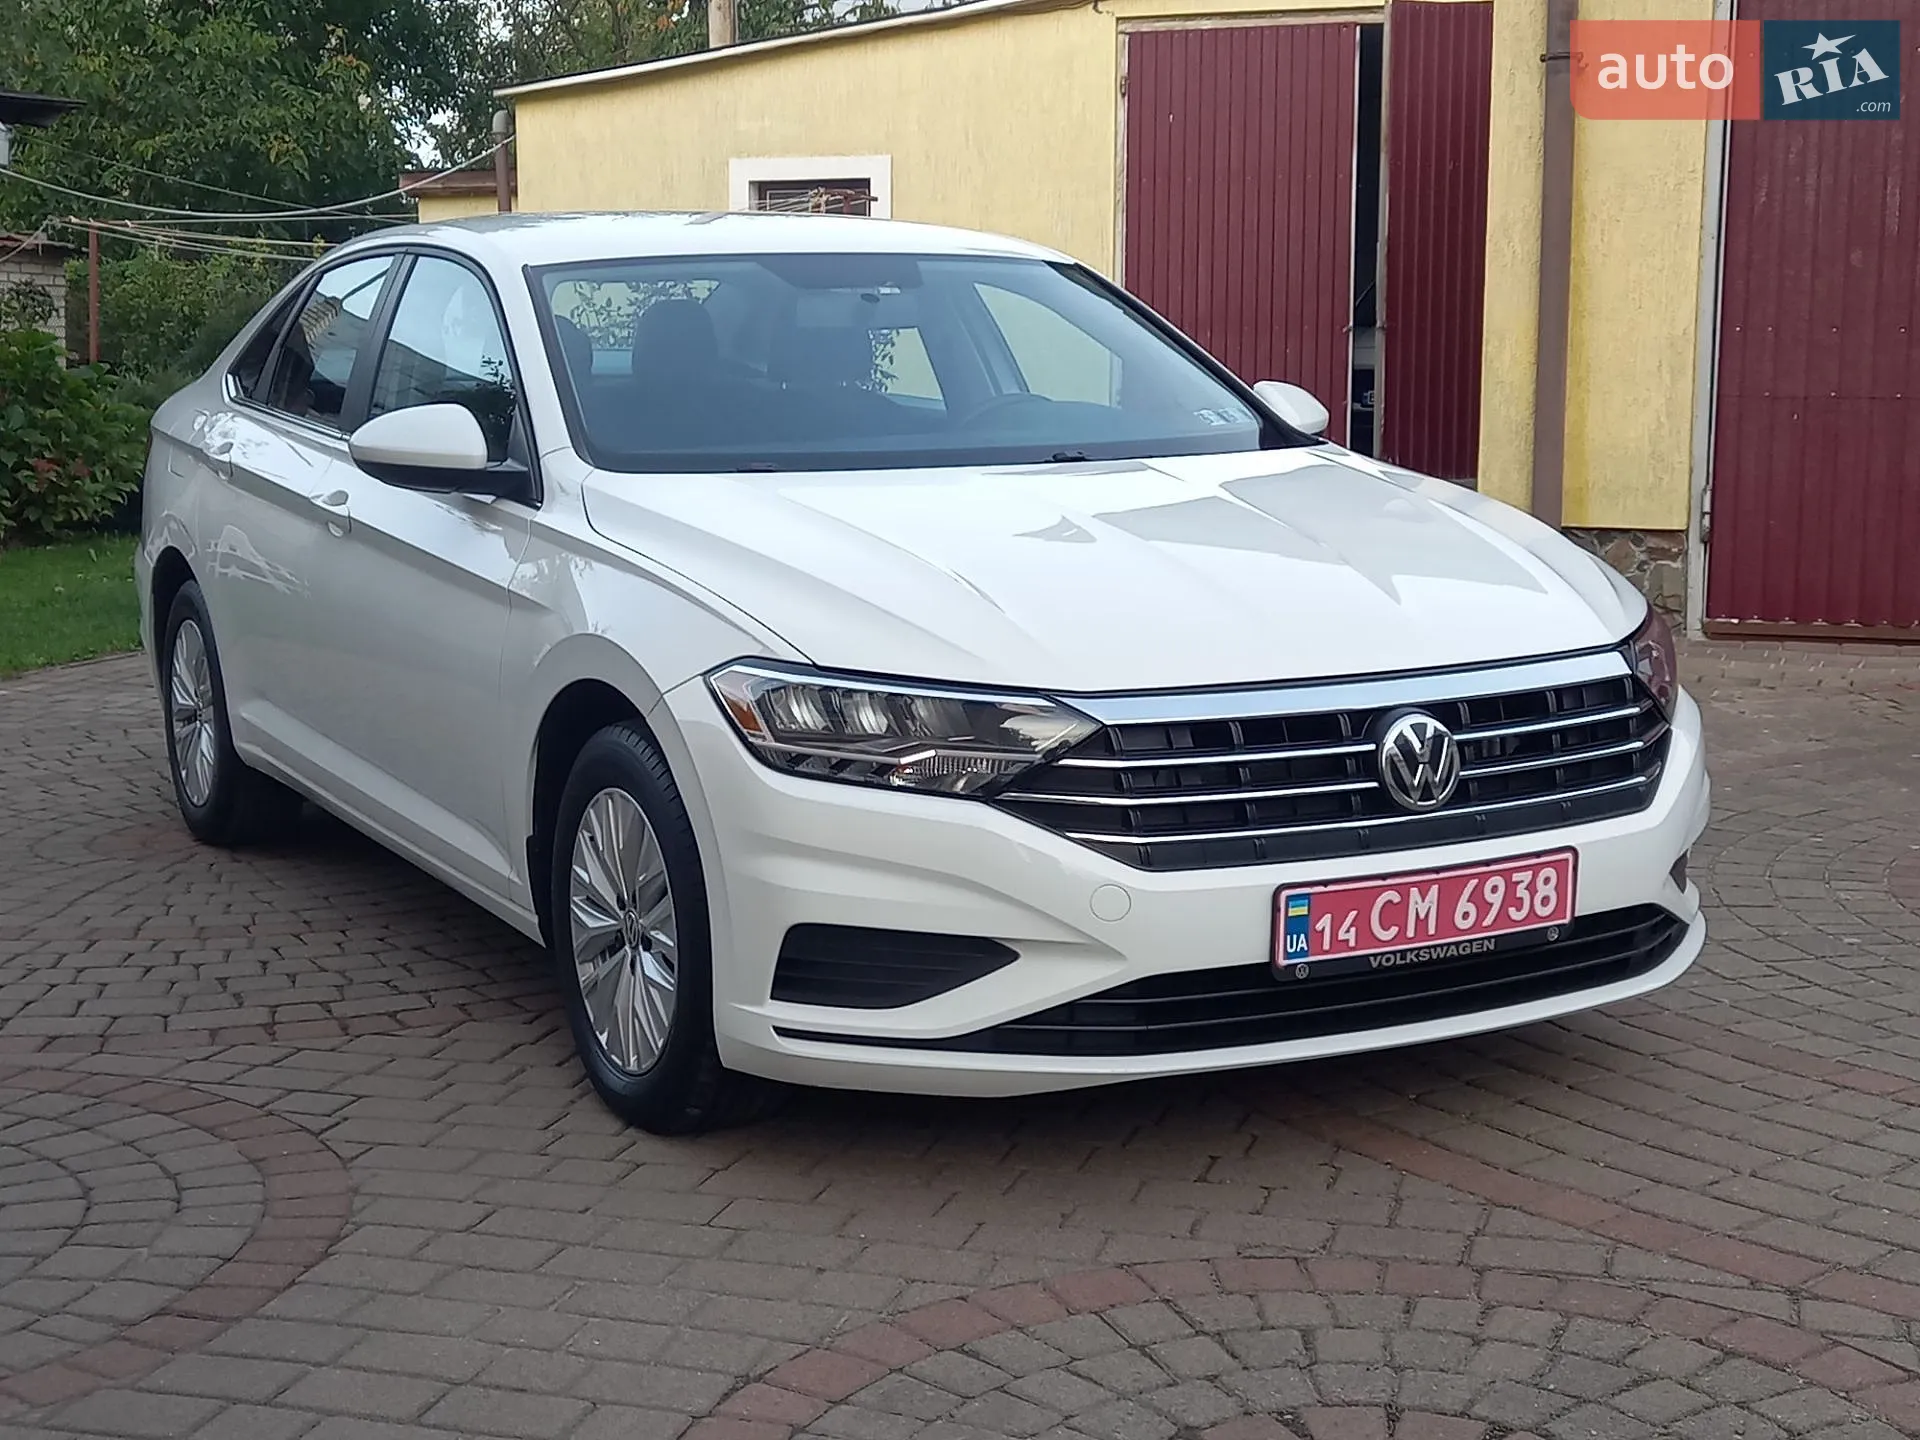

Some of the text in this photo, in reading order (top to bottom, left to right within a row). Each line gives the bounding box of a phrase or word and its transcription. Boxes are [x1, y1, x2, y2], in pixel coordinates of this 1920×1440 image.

[1315, 867, 1558, 951] 14 CM 6938
[1287, 934, 1308, 953] UA
[1369, 939, 1495, 968] VOLKSWAGEN
